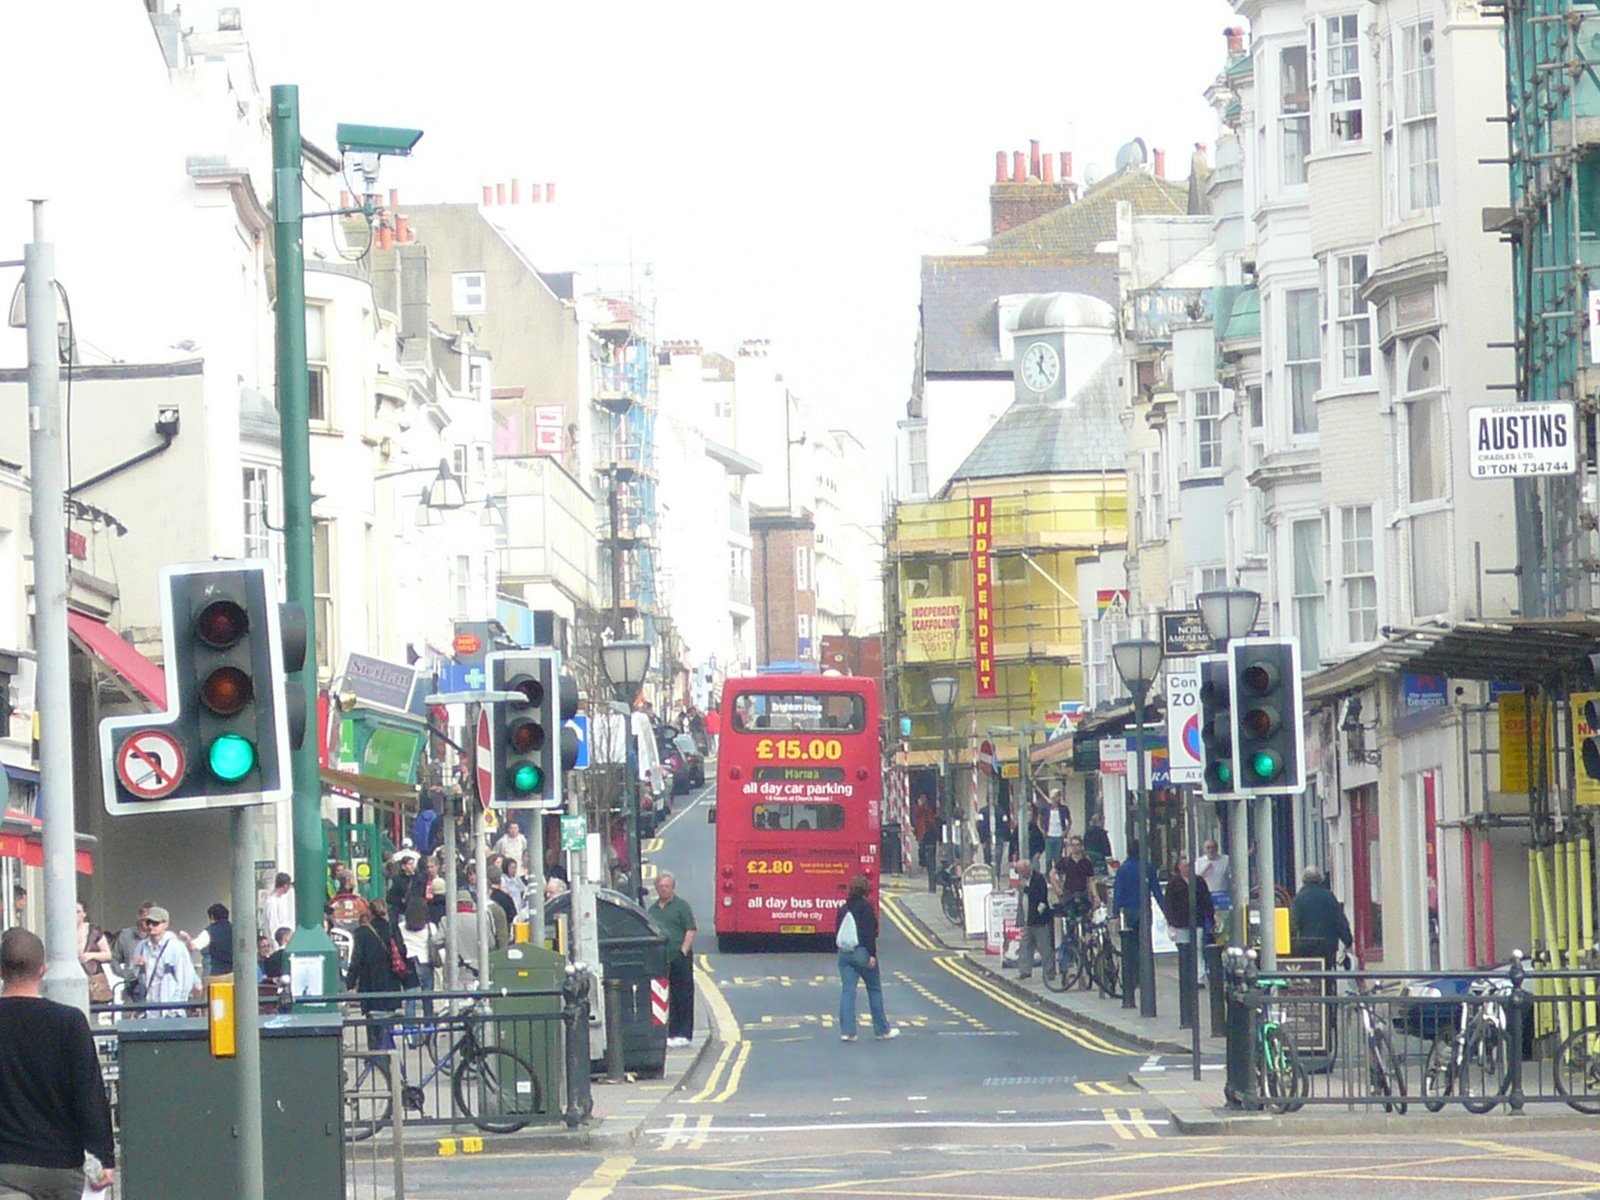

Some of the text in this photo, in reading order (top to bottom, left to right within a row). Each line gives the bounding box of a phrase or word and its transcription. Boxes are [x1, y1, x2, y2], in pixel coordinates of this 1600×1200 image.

[1477, 413, 1567, 451] AUSTINS
[1478, 453, 1516, 462] CRADLES
[1478, 461, 1569, 475] B'TON 734744
[976, 503, 991, 690] INDEPENDENT
[911, 605, 960, 617] INDEPENDENT
[1178, 625, 1206, 634] NOBL
[1170, 677, 1197, 688] Con
[1172, 692, 1196, 707] ZO
[1407, 696, 1446, 706] beacon
[756, 739, 842, 760] £15.00
[743, 782, 853, 797] all day car parking
[746, 860, 794, 874] £2.80
[747, 896, 847, 910] all day bus trave
[771, 911, 823, 920] around the city
